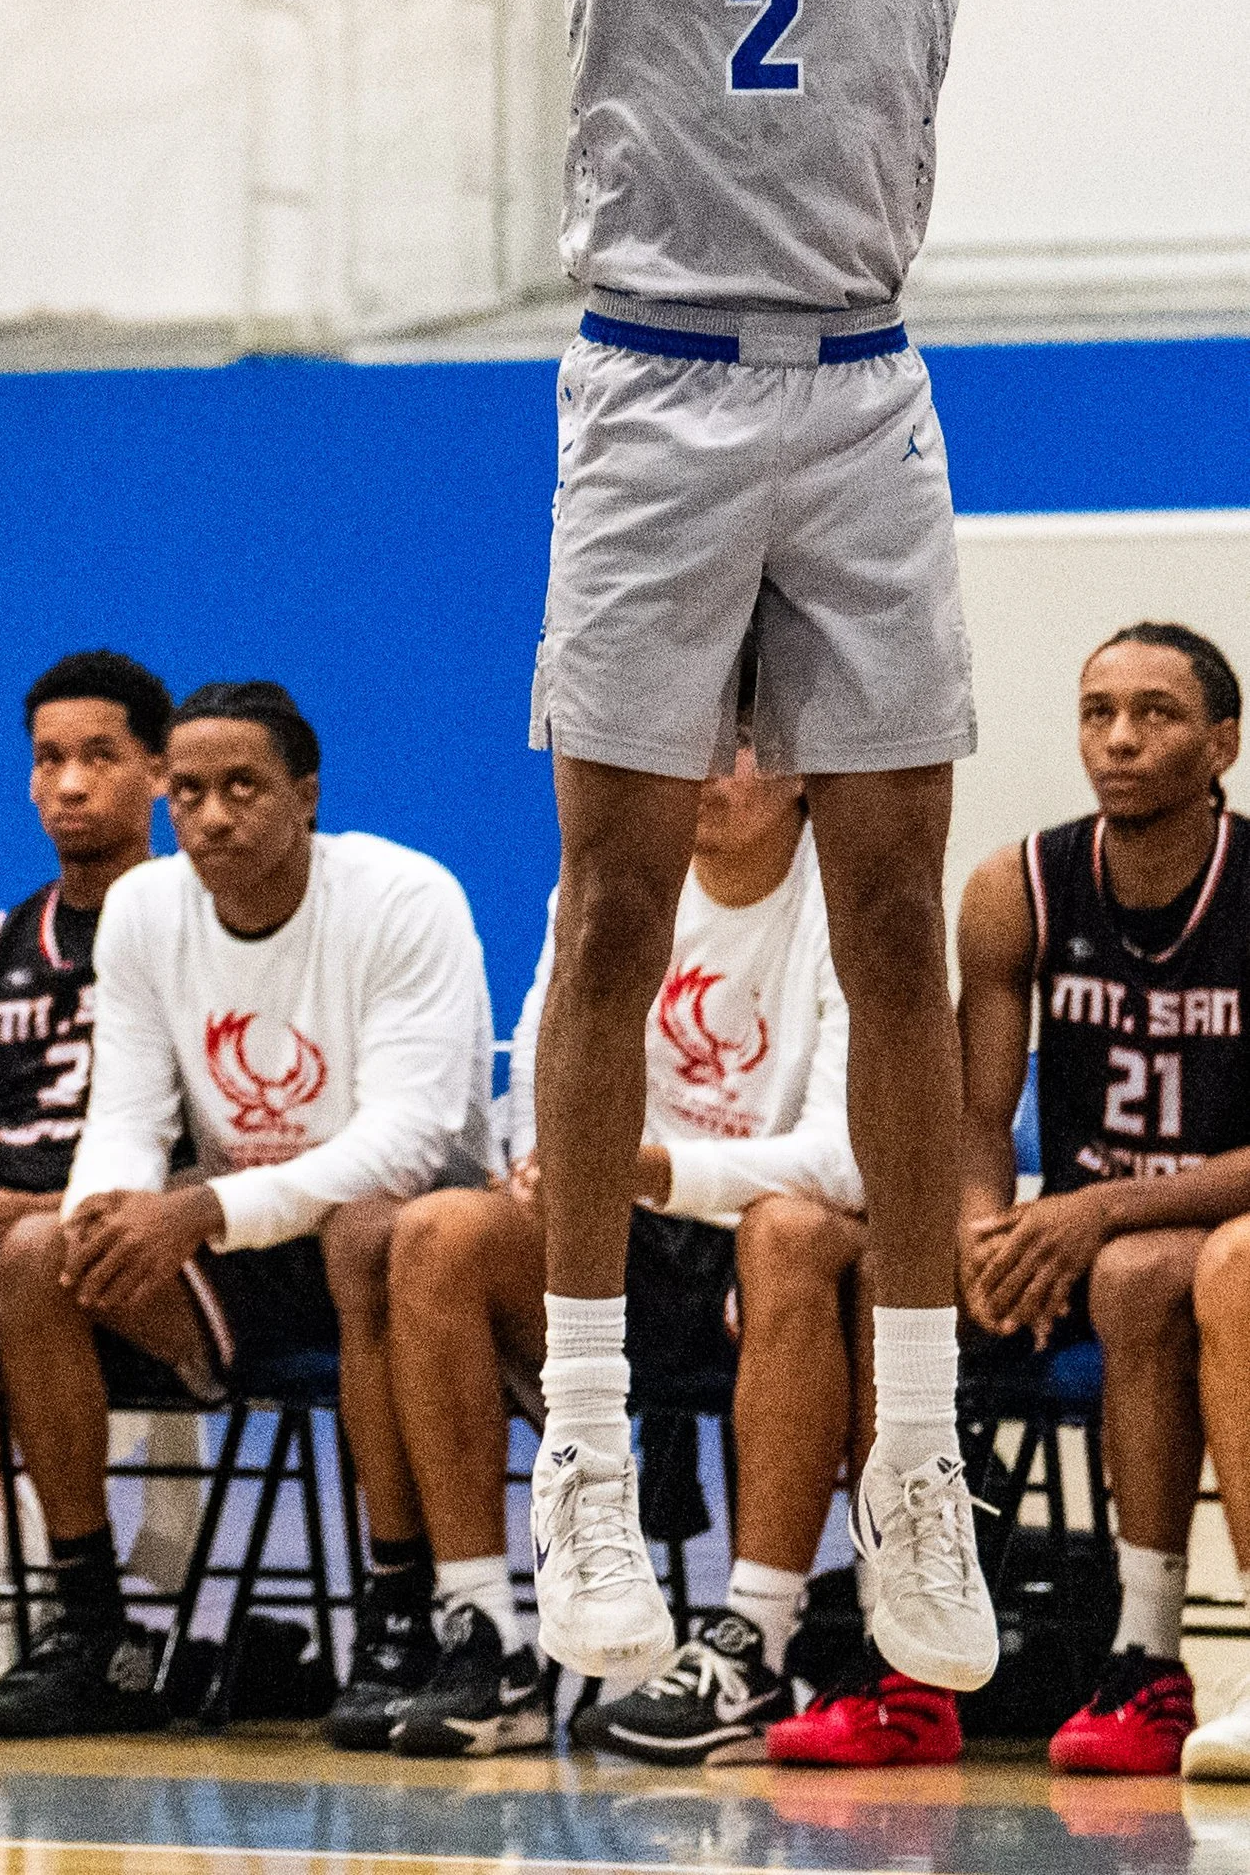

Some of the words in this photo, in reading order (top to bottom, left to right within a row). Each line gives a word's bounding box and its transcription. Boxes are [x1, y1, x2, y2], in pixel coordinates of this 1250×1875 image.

[1052, 975, 1135, 1034] MT.
[1147, 988, 1241, 1037] SAN
[1104, 1046, 1182, 1137] 21
